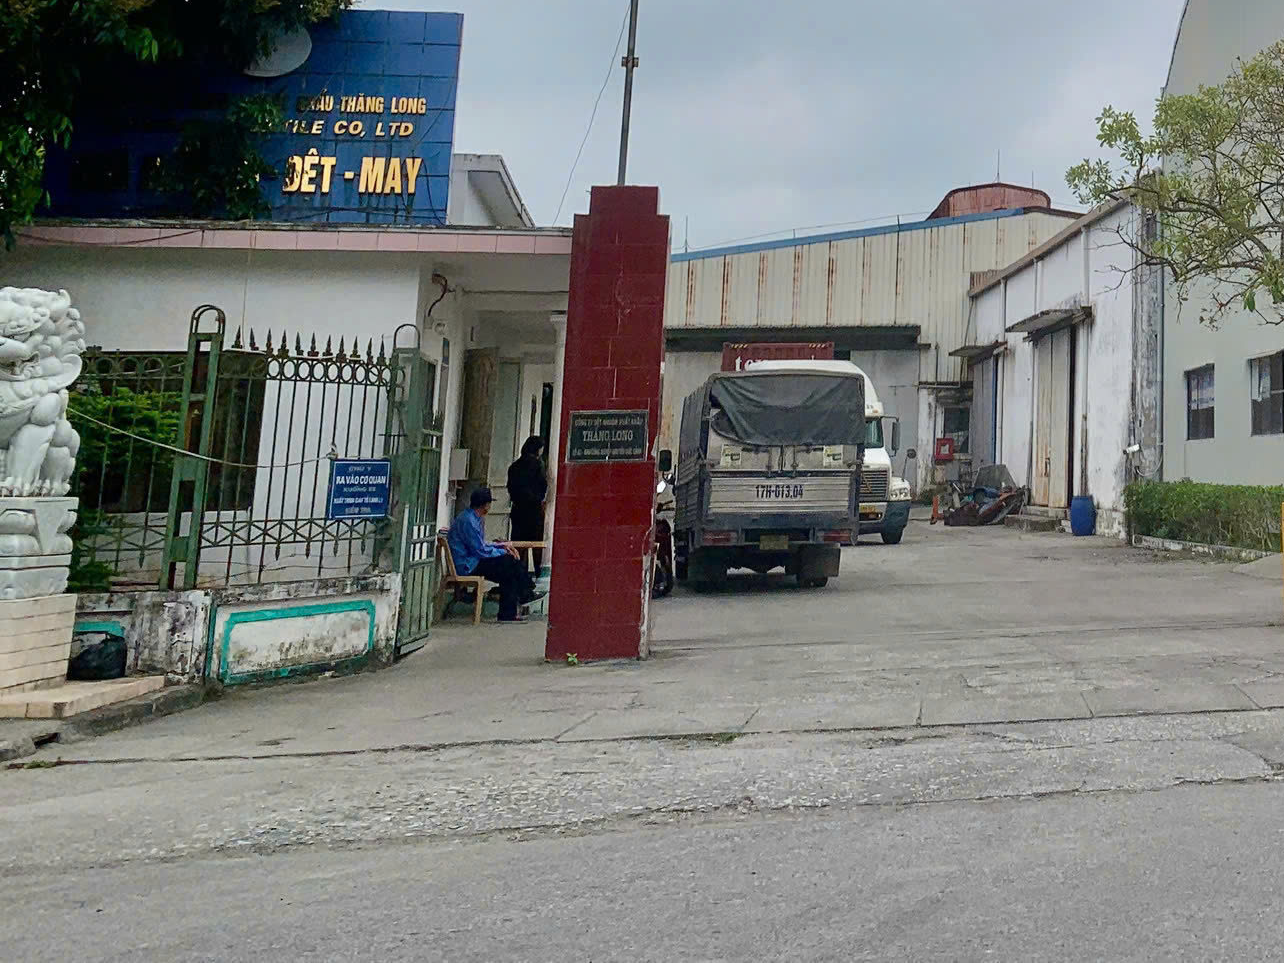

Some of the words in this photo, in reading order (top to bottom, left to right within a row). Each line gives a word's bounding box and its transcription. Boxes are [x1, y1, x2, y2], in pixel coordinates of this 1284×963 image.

[341, 93, 385, 113] THĂNG
[391, 97, 427, 114] LONG
[375, 122, 414, 136] LTD
[358, 156, 422, 194] MAY
[346, 474, 359, 484] VÀO
